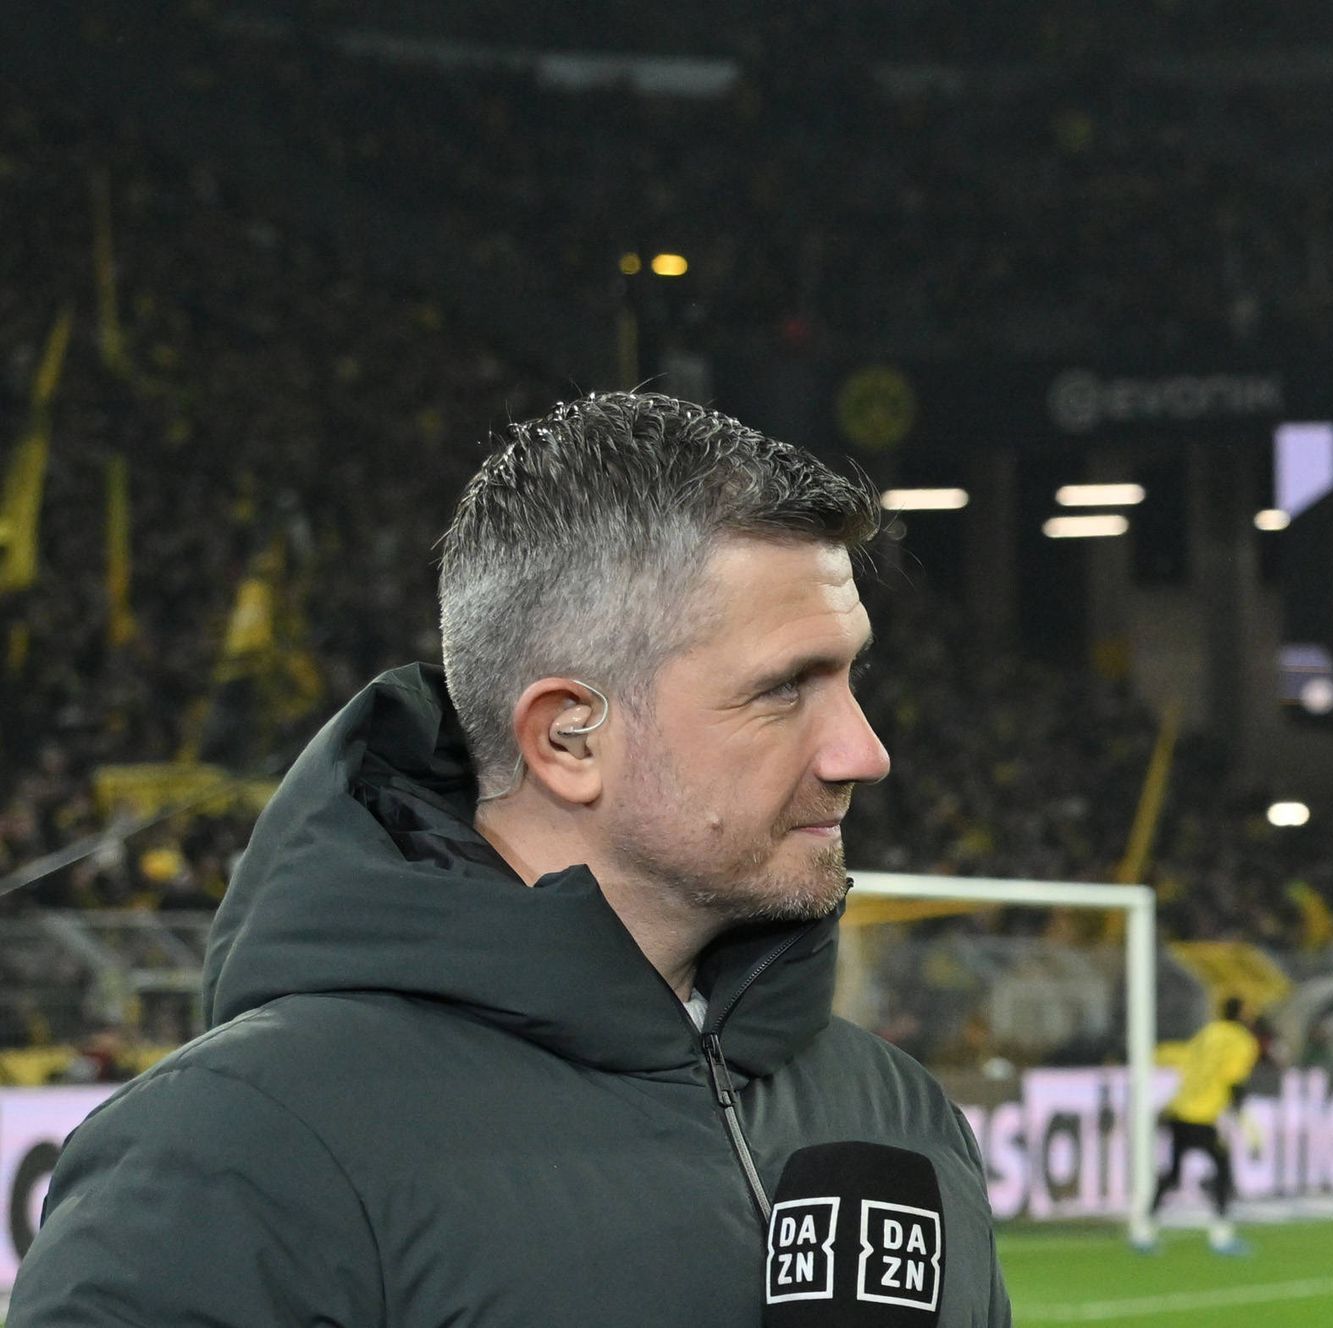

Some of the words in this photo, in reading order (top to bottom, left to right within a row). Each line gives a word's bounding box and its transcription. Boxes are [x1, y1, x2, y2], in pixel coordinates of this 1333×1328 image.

[779, 1215, 817, 1247] DA
[883, 1219, 927, 1255] DA
[778, 1251, 814, 1285] ZN
[881, 1255, 925, 1292] ZN
